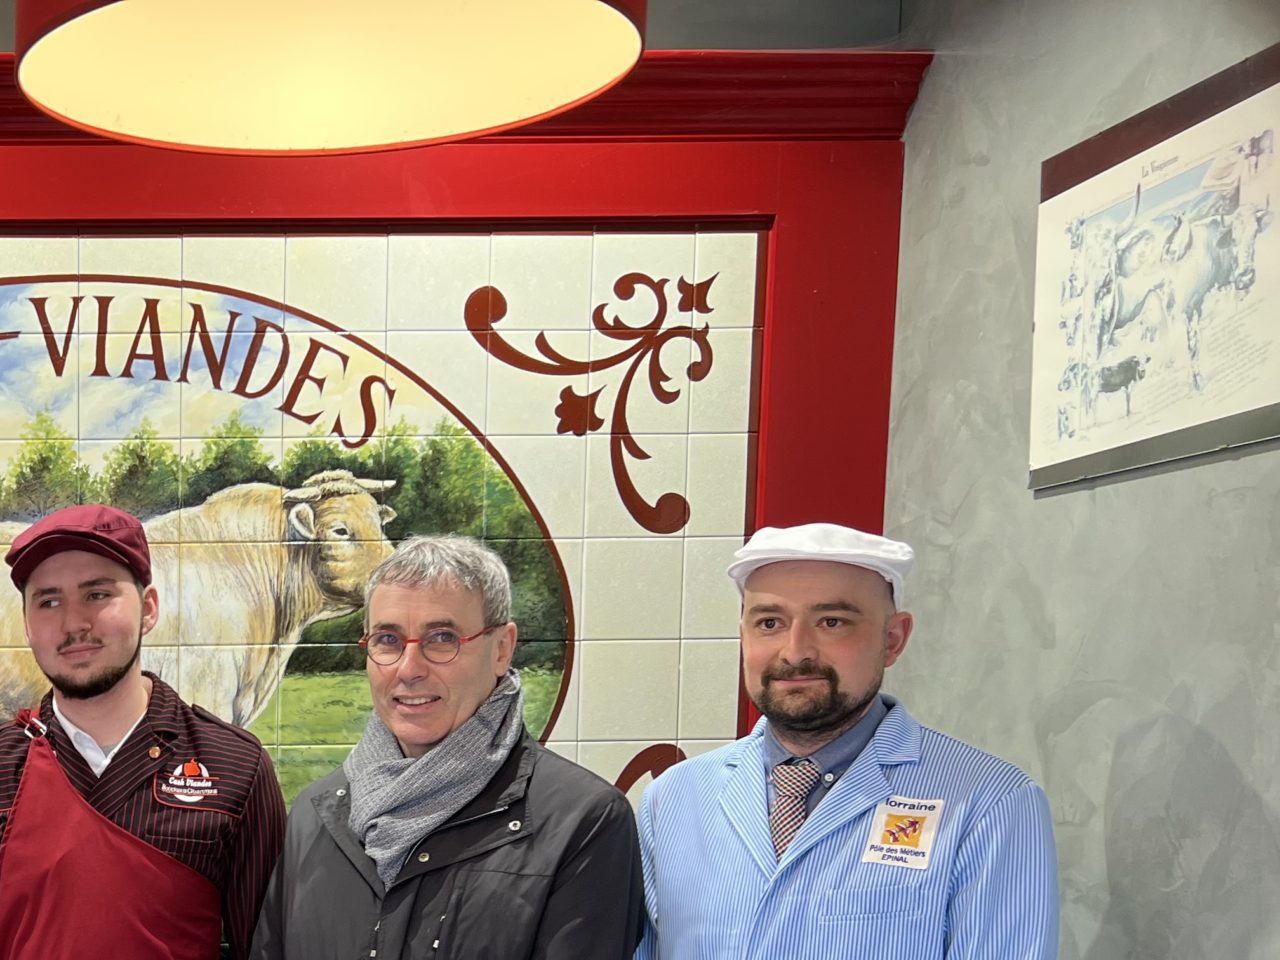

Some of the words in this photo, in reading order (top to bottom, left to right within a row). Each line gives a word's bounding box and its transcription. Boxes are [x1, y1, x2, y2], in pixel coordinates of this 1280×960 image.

[169, 776, 184, 786] Cash
[186, 778, 212, 787] Viandes
[885, 798, 936, 811] lorraine
[881, 854, 909, 863] EPINAL
